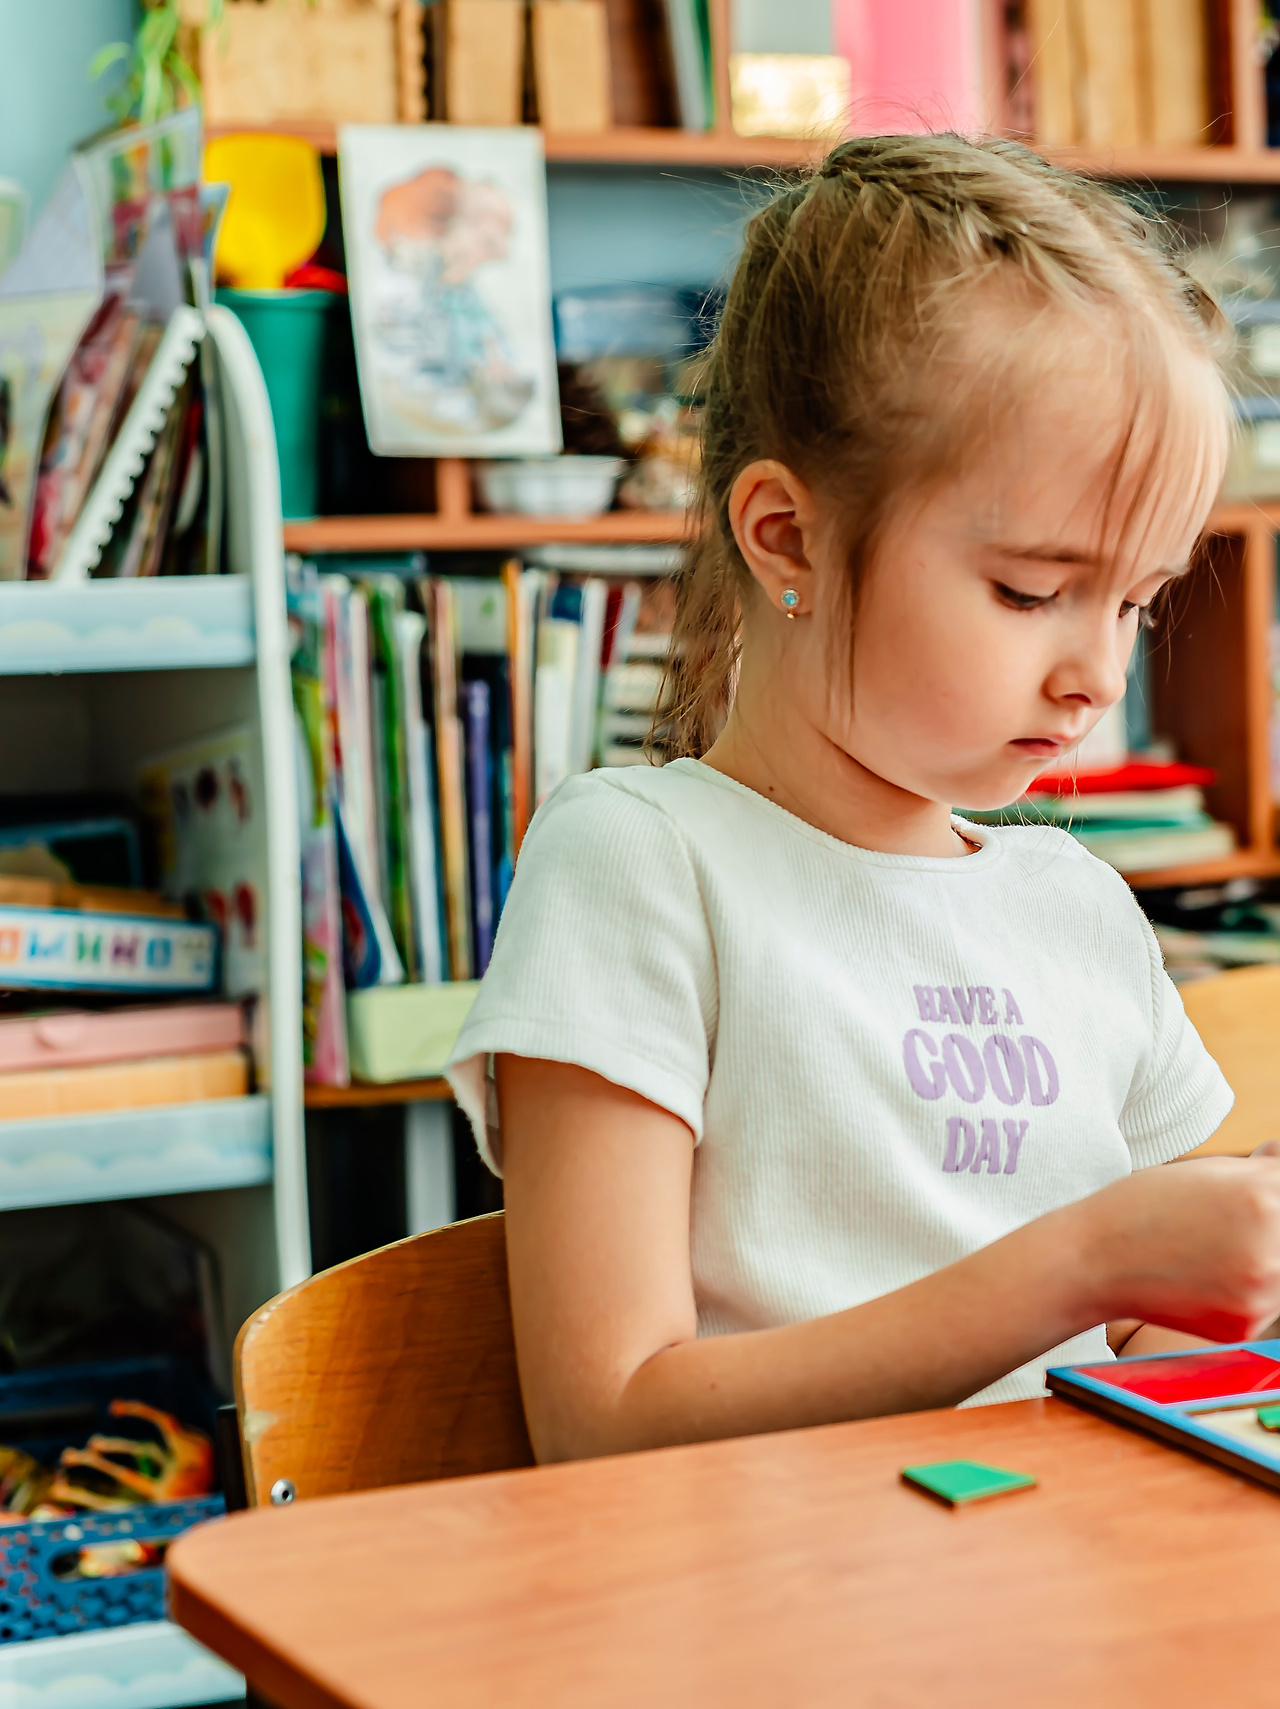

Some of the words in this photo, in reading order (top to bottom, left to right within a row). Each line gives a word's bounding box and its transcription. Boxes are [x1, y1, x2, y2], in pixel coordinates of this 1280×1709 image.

[913, 984, 998, 1025] HAVE
[1001, 988, 1024, 1025] A
[902, 1028, 1060, 1106] GOOD
[942, 1116, 1029, 1175] DAY
